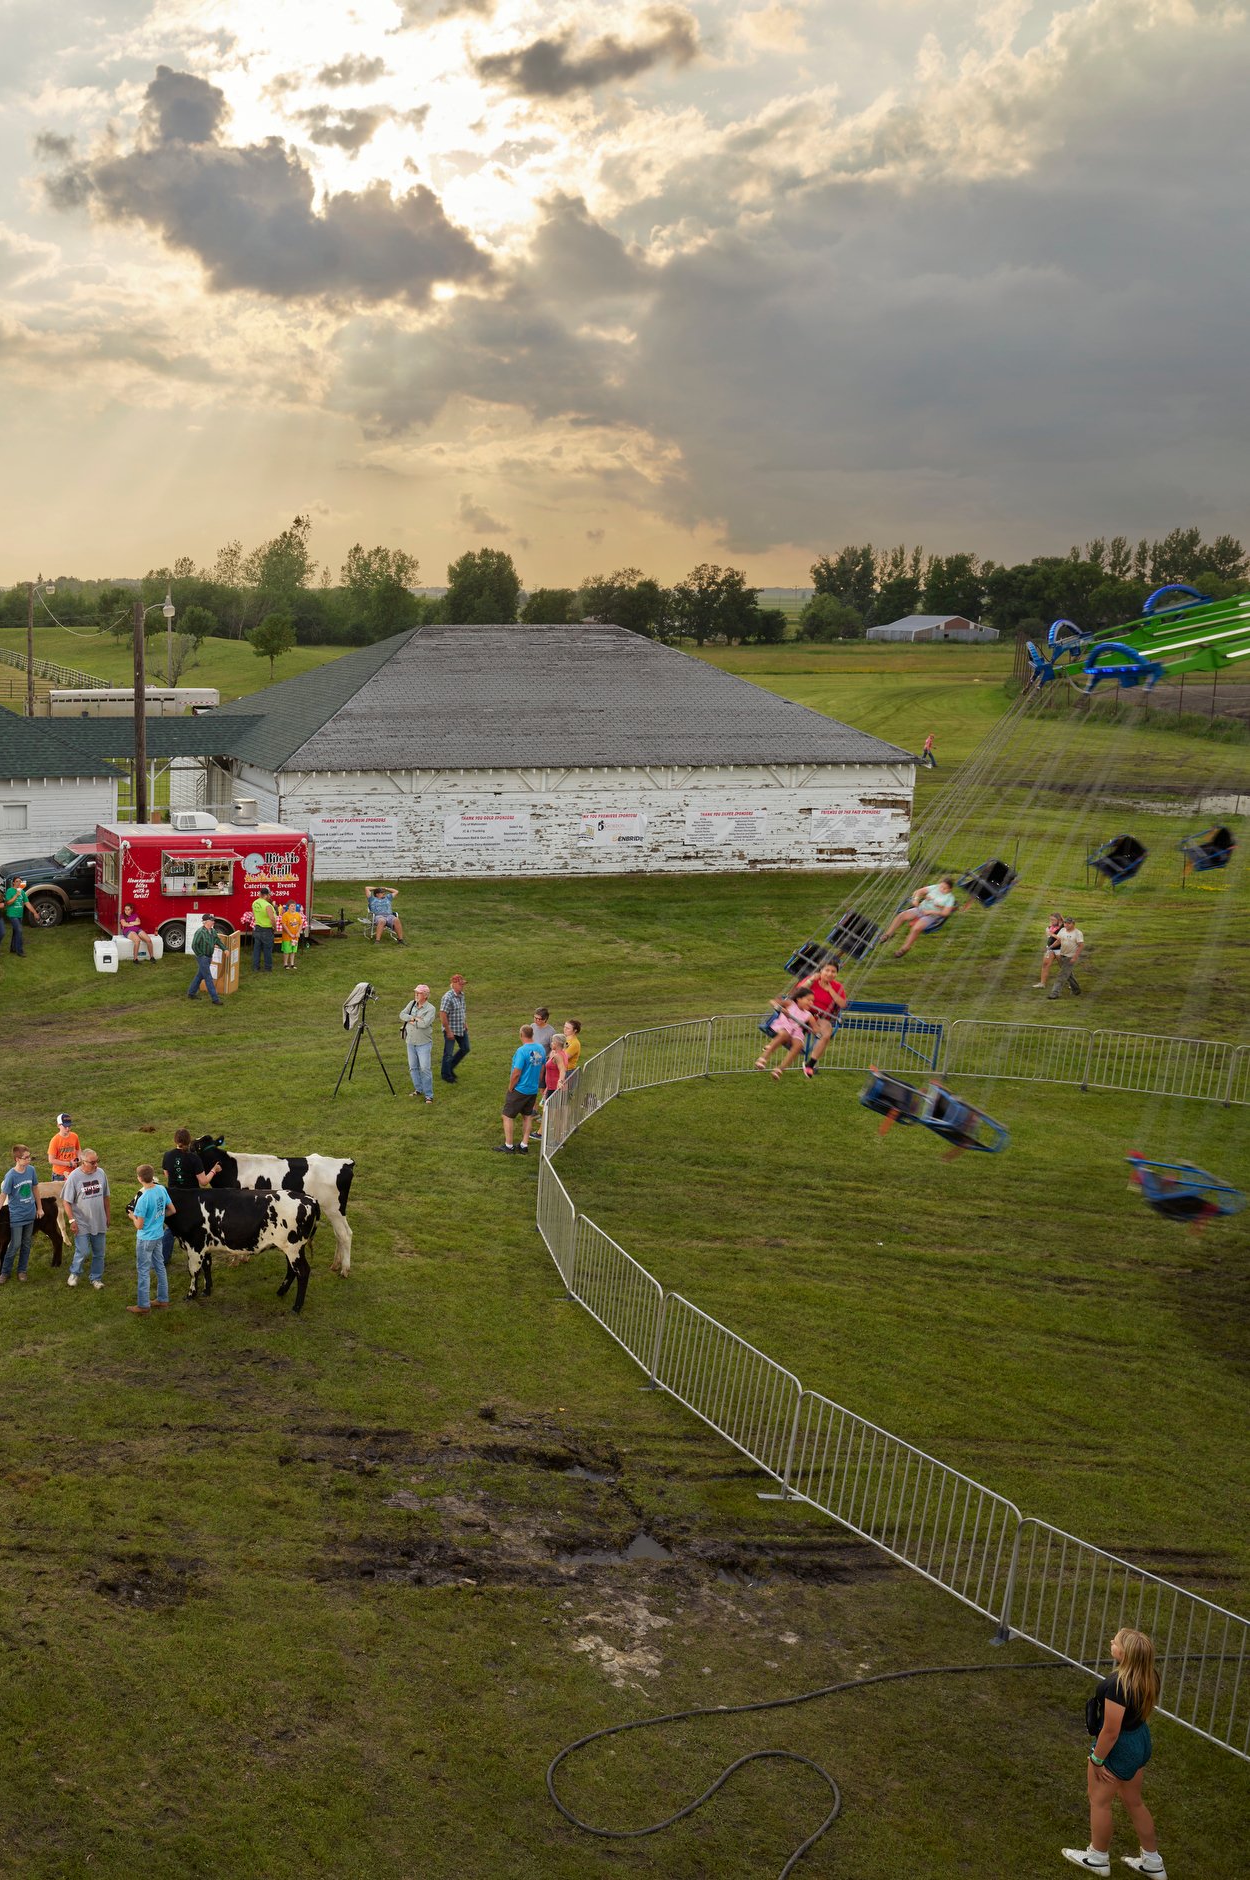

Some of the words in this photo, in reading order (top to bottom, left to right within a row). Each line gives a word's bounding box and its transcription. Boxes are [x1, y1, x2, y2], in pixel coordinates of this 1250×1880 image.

[265, 852, 284, 864] Bite
[285, 852, 300, 863] Me
[270, 864, 291, 876] Grill
